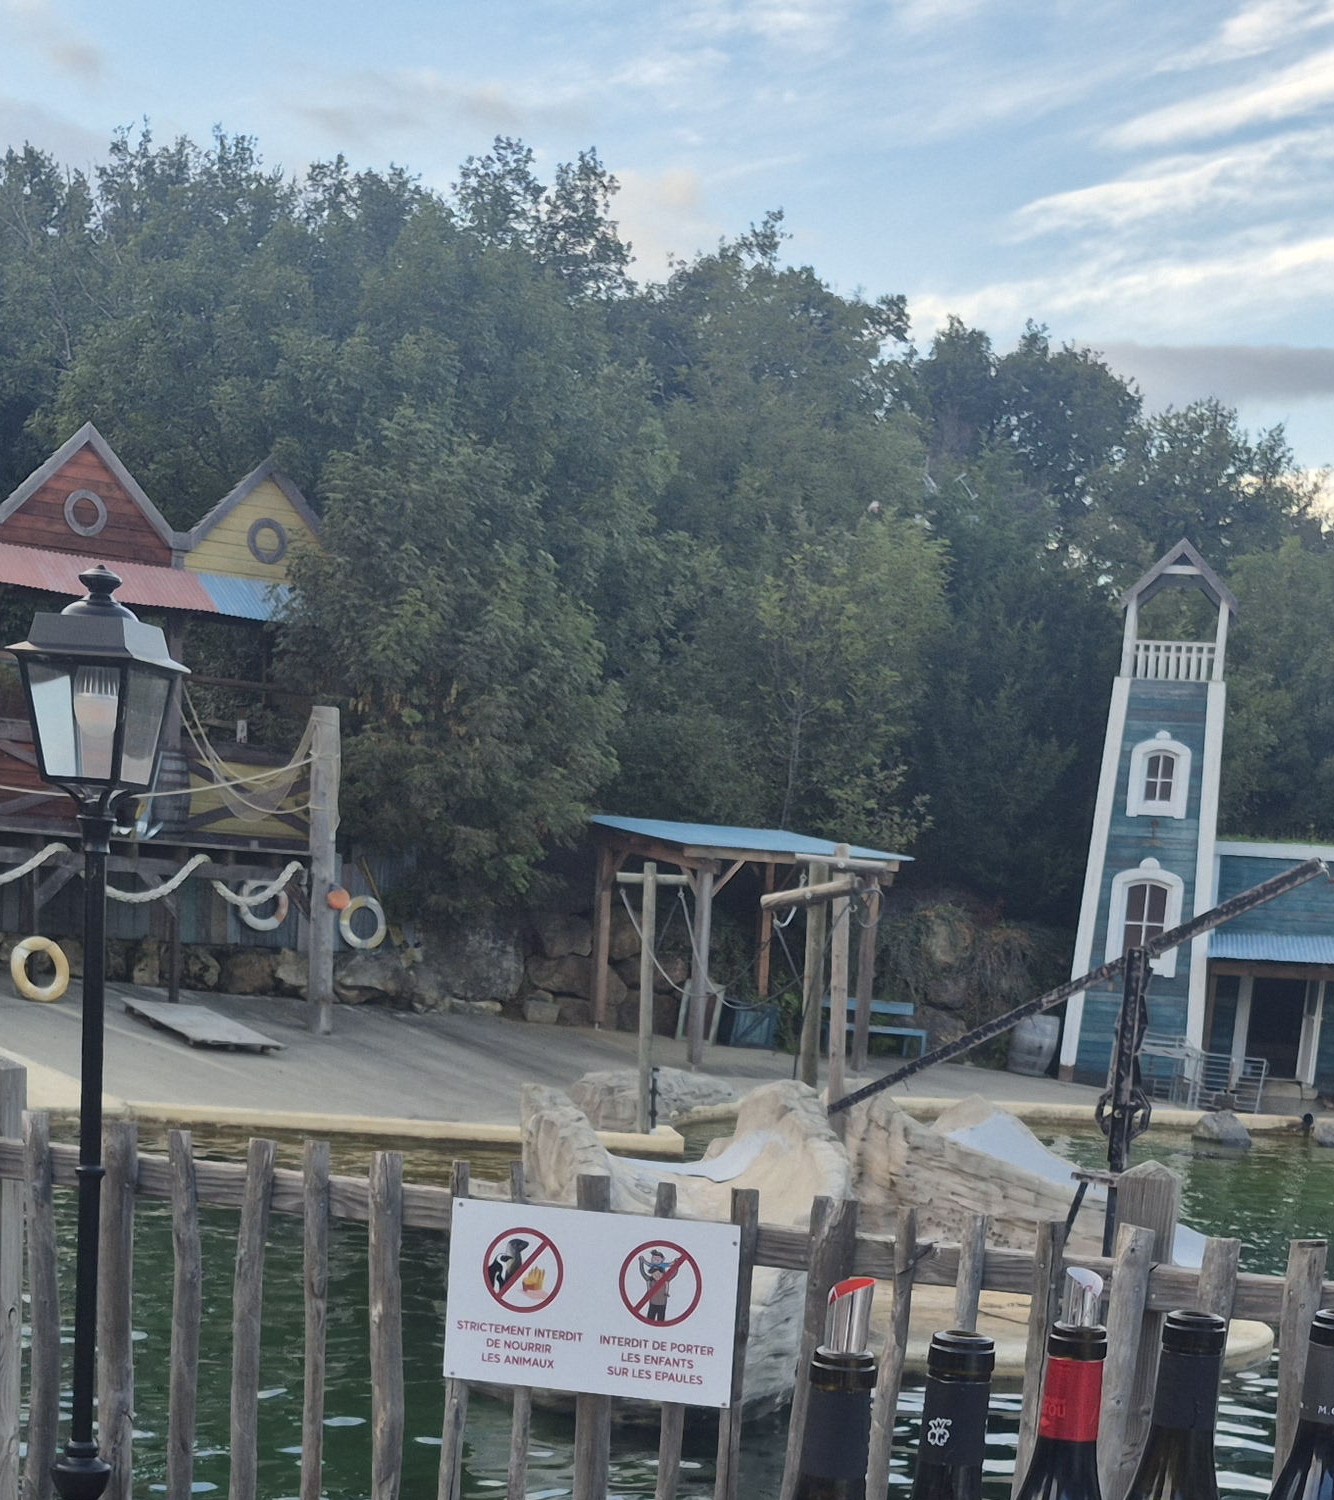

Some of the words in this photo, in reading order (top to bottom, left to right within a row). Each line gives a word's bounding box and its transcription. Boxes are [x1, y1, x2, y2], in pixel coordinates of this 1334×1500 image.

[456, 1319, 531, 1338] STRICTEMENT
[534, 1327, 584, 1343] INTERDIT
[486, 1338, 502, 1349] DE
[504, 1340, 552, 1355] NOURRIR
[599, 1334, 650, 1350] INTERDIT
[652, 1340, 667, 1352] DE
[669, 1342, 714, 1357] PORTER
[481, 1352, 501, 1364] LES
[503, 1355, 555, 1370] ANIMAUX
[620, 1352, 641, 1364] LES
[643, 1354, 694, 1370] ENFANTS
[607, 1366, 629, 1378] SUR
[631, 1368, 652, 1380] LES
[655, 1371, 703, 1385] EPAULES
